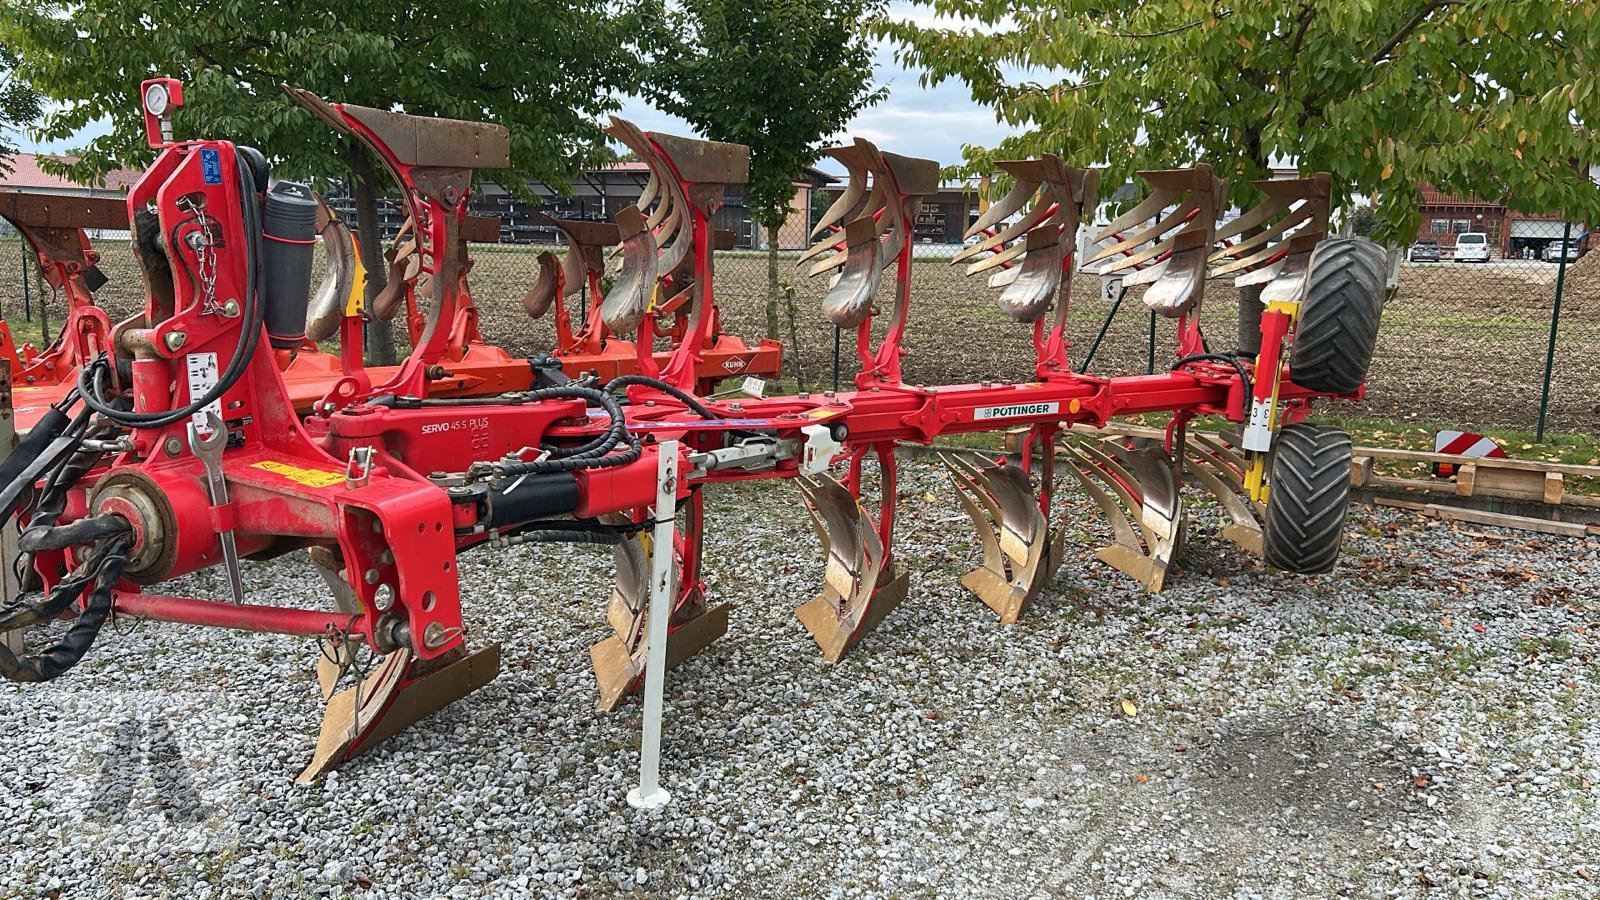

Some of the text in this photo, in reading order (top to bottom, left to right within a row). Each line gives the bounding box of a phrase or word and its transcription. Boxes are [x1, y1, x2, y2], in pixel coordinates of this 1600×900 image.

[1252, 408, 1258, 418] 3
[421, 417, 489, 435] SERVO 45 S PLUS
